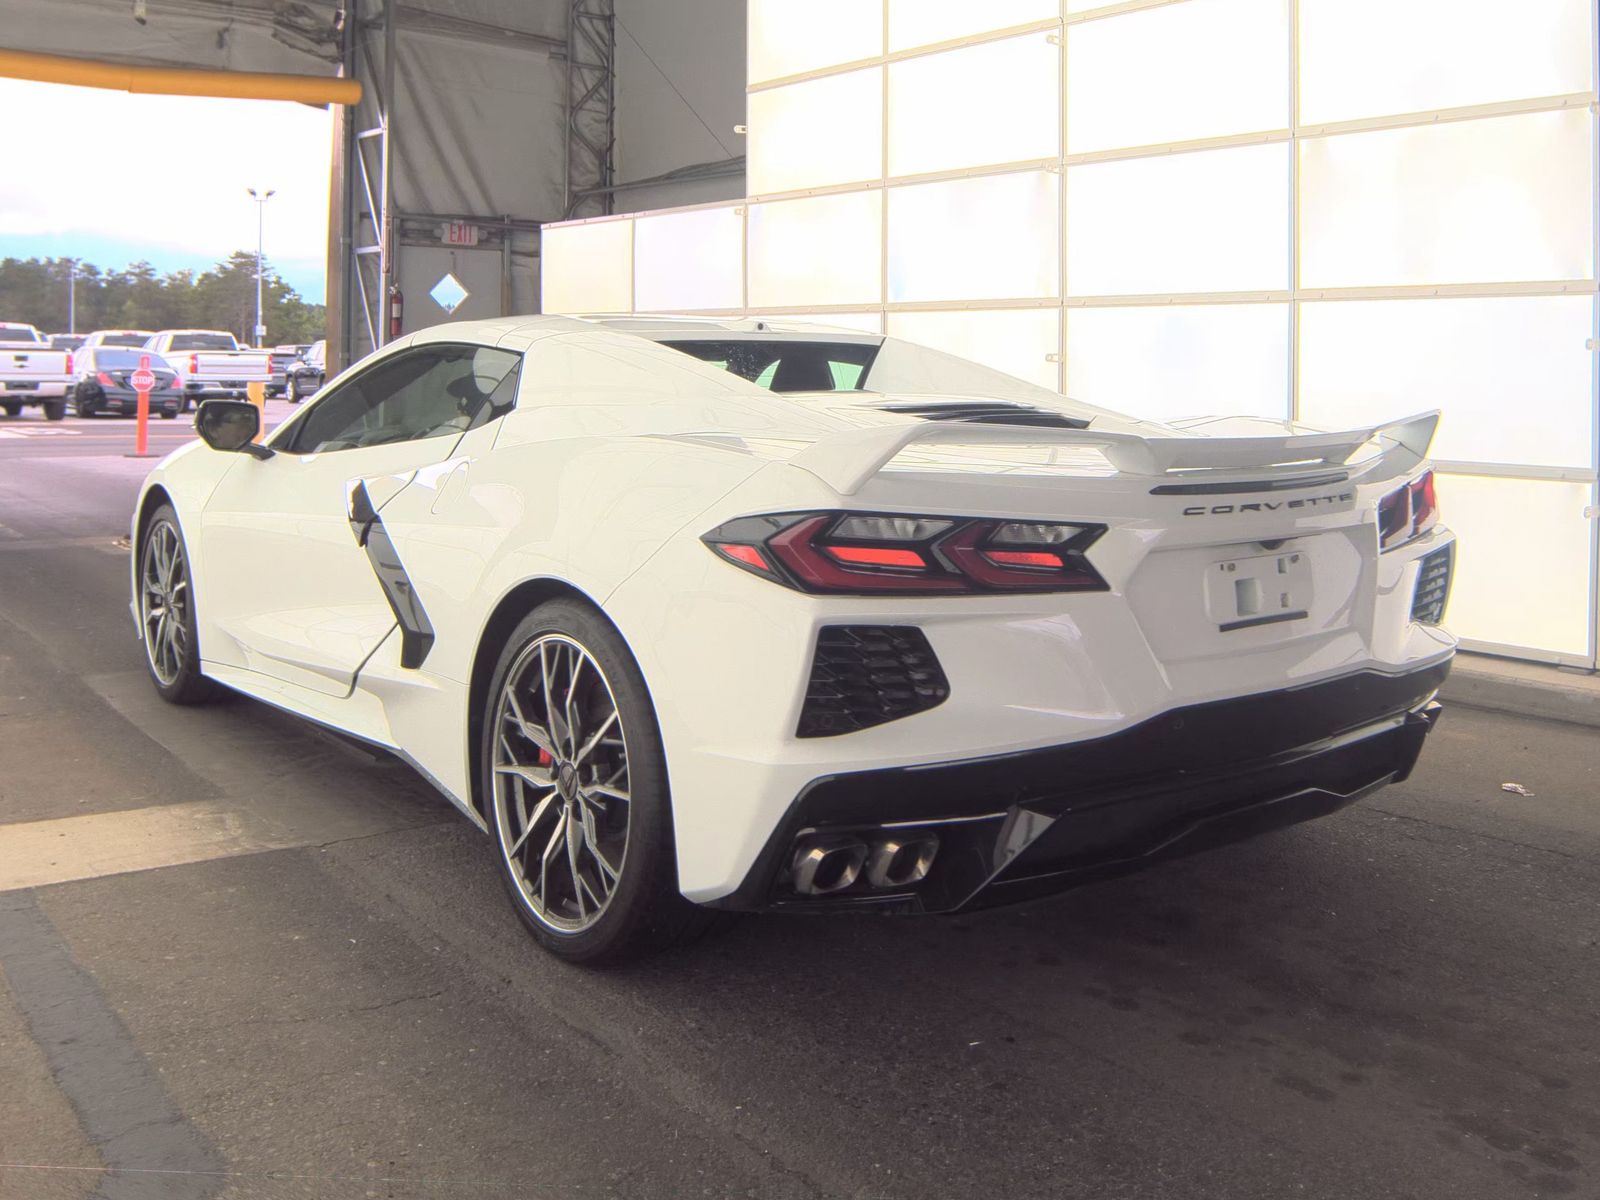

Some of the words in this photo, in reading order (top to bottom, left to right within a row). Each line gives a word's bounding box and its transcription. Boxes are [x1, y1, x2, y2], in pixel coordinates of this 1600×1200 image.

[450, 224, 472, 243] EXIT
[132, 375, 153, 385] STOP
[1182, 493, 1353, 516] CORVETTE
